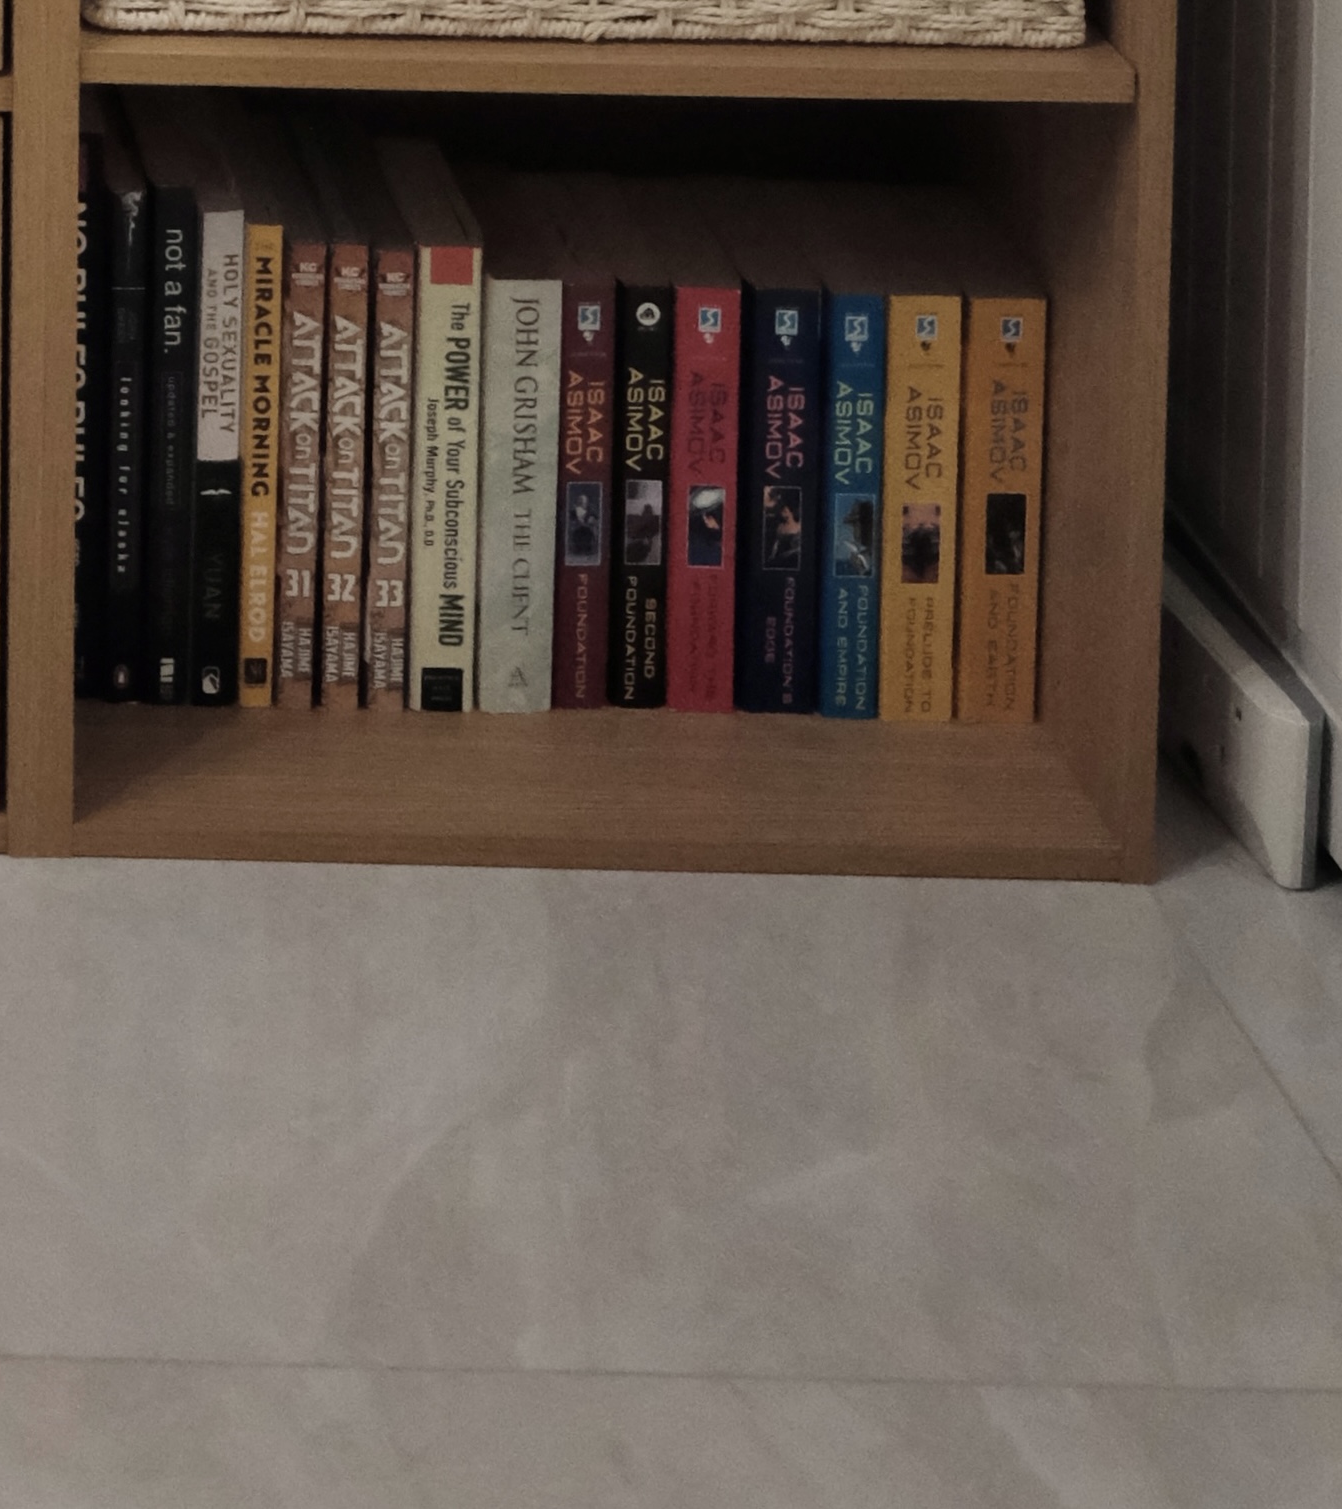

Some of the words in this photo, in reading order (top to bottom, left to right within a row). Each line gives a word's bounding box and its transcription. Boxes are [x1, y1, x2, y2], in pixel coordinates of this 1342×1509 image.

[165, 229, 185, 270] not
[165, 281, 181, 296] a
[223, 254, 239, 307] HOLY
[164, 305, 186, 353] fan.
[204, 305, 216, 330] THE
[254, 256, 273, 366] MIRACLE
[449, 302, 471, 331] The
[510, 295, 539, 368] JOHN
[201, 337, 220, 418] GOSPEL
[219, 316, 238, 433] SEXUALITY
[290, 311, 321, 432] ATTACK
[333, 315, 364, 435] ATTACK
[377, 321, 407, 441] ATTACK
[443, 336, 470, 410] POWER
[116, 377, 133, 452] looking
[251, 375, 271, 496] MORNING
[294, 433, 312, 461] on
[336, 436, 355, 462] on
[446, 417, 465, 432] of
[511, 376, 538, 495] GRISHAM
[565, 370, 584, 475] ASIMOV
[586, 380, 605, 463] ISAAC
[625, 367, 645, 472] ASIMOV
[645, 379, 666, 460] ISAAC
[687, 372, 707, 477] ASIMOV
[708, 382, 727, 464] ISAAC
[765, 375, 784, 479] ASIMOV
[785, 386, 805, 468] ISAAC
[834, 380, 853, 485] ASIMOV
[855, 392, 874, 473] ISAAC
[904, 386, 923, 490] ASIMOV
[925, 397, 943, 479] ISAAC
[988, 380, 1008, 483] ASIMOV
[1009, 391, 1027, 472] ISAAC
[119, 466, 131, 495] for
[382, 443, 402, 470] on
[445, 439, 466, 475] Your
[250, 511, 267, 559] HAL
[286, 461, 315, 554] TITAN
[329, 462, 359, 559] TITAN
[376, 471, 405, 564] TITAN
[442, 480, 465, 589] Subconscious
[513, 509, 533, 551] THE
[248, 565, 265, 642] ELROD
[285, 569, 312, 597] 31
[327, 573, 357, 602] 32
[375, 580, 402, 607] 33
[437, 594, 464, 647] MIND
[510, 558, 531, 636] CLIENT
[837, 588, 847, 628] AND
[574, 573, 589, 699] FOUNDATION
[624, 575, 638, 701] FOUNDATION
[643, 598, 657, 679] SECOND
[835, 636, 847, 707] EMPIRE
[856, 584, 868, 711] FOUNDATION
[903, 597, 916, 713] FOUNDATION
[921, 597, 934, 683] PRELUDE
[1005, 584, 1018, 710] FOUNDATION
[921, 690, 933, 713] TO
